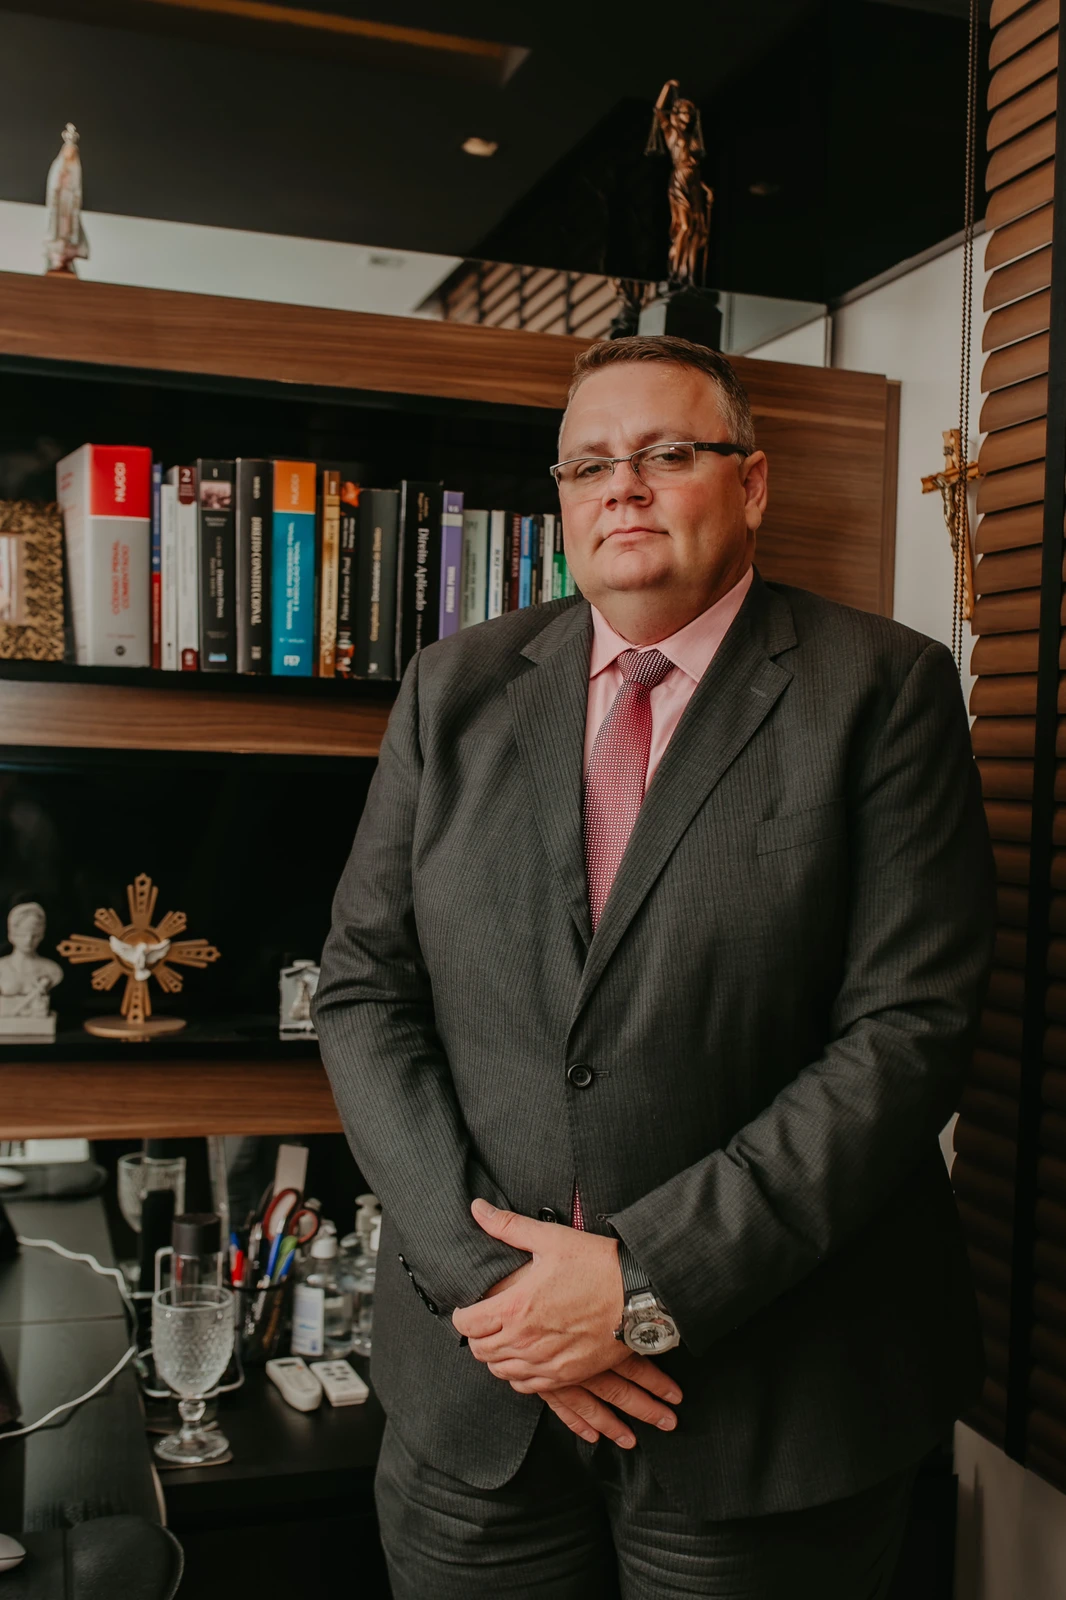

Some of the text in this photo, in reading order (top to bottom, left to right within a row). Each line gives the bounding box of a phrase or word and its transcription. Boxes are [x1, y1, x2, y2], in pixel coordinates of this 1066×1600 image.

[114, 461, 127, 503] NUCCI
[180, 468, 192, 483] 2
[290, 473, 300, 505] NUCCI
[287, 522, 296, 546] PENAL
[417, 527, 430, 564] Direito
[112, 539, 121, 574] PENAL
[250, 516, 263, 626] DIREITO CONSTITUCIONAL
[120, 544, 131, 610] COMENTADO
[413, 565, 428, 611] Aplicado
